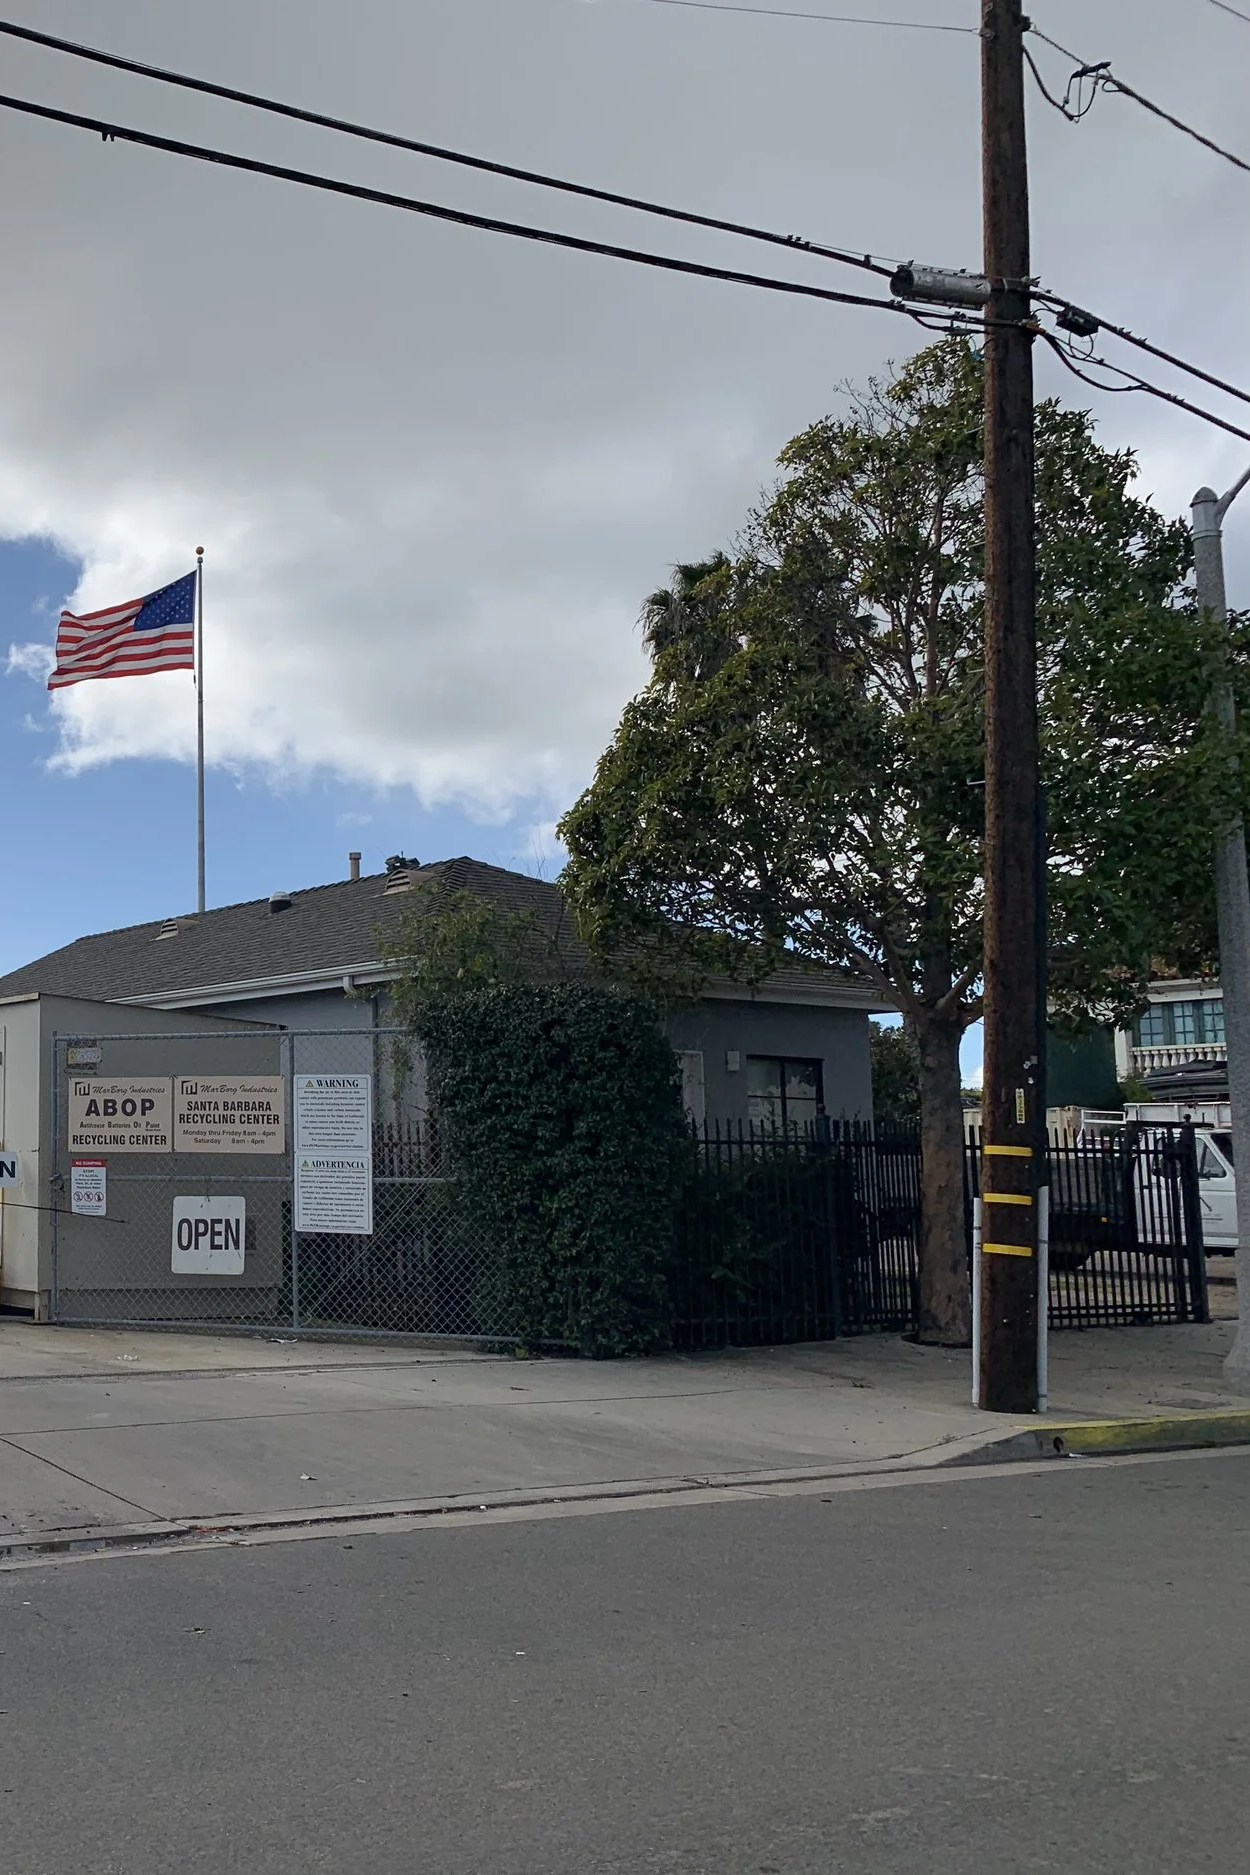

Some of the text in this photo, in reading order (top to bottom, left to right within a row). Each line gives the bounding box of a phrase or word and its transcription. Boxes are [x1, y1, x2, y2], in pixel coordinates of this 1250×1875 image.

[316, 1079, 359, 1088] WARNING
[92, 1085, 165, 1096] MarBorg Industries
[200, 1084, 278, 1095] MarBorg Industries
[85, 1098, 155, 1117] ABOP
[187, 1101, 272, 1112] SANTA BARBARA
[179, 1113, 280, 1125] RECYCLING CENTER
[145, 1121, 160, 1129] Paint
[72, 1134, 167, 1145] RECYCLING CENTER
[311, 1160, 365, 1169] ADVERTENCIA
[177, 1217, 240, 1251] OPEN
